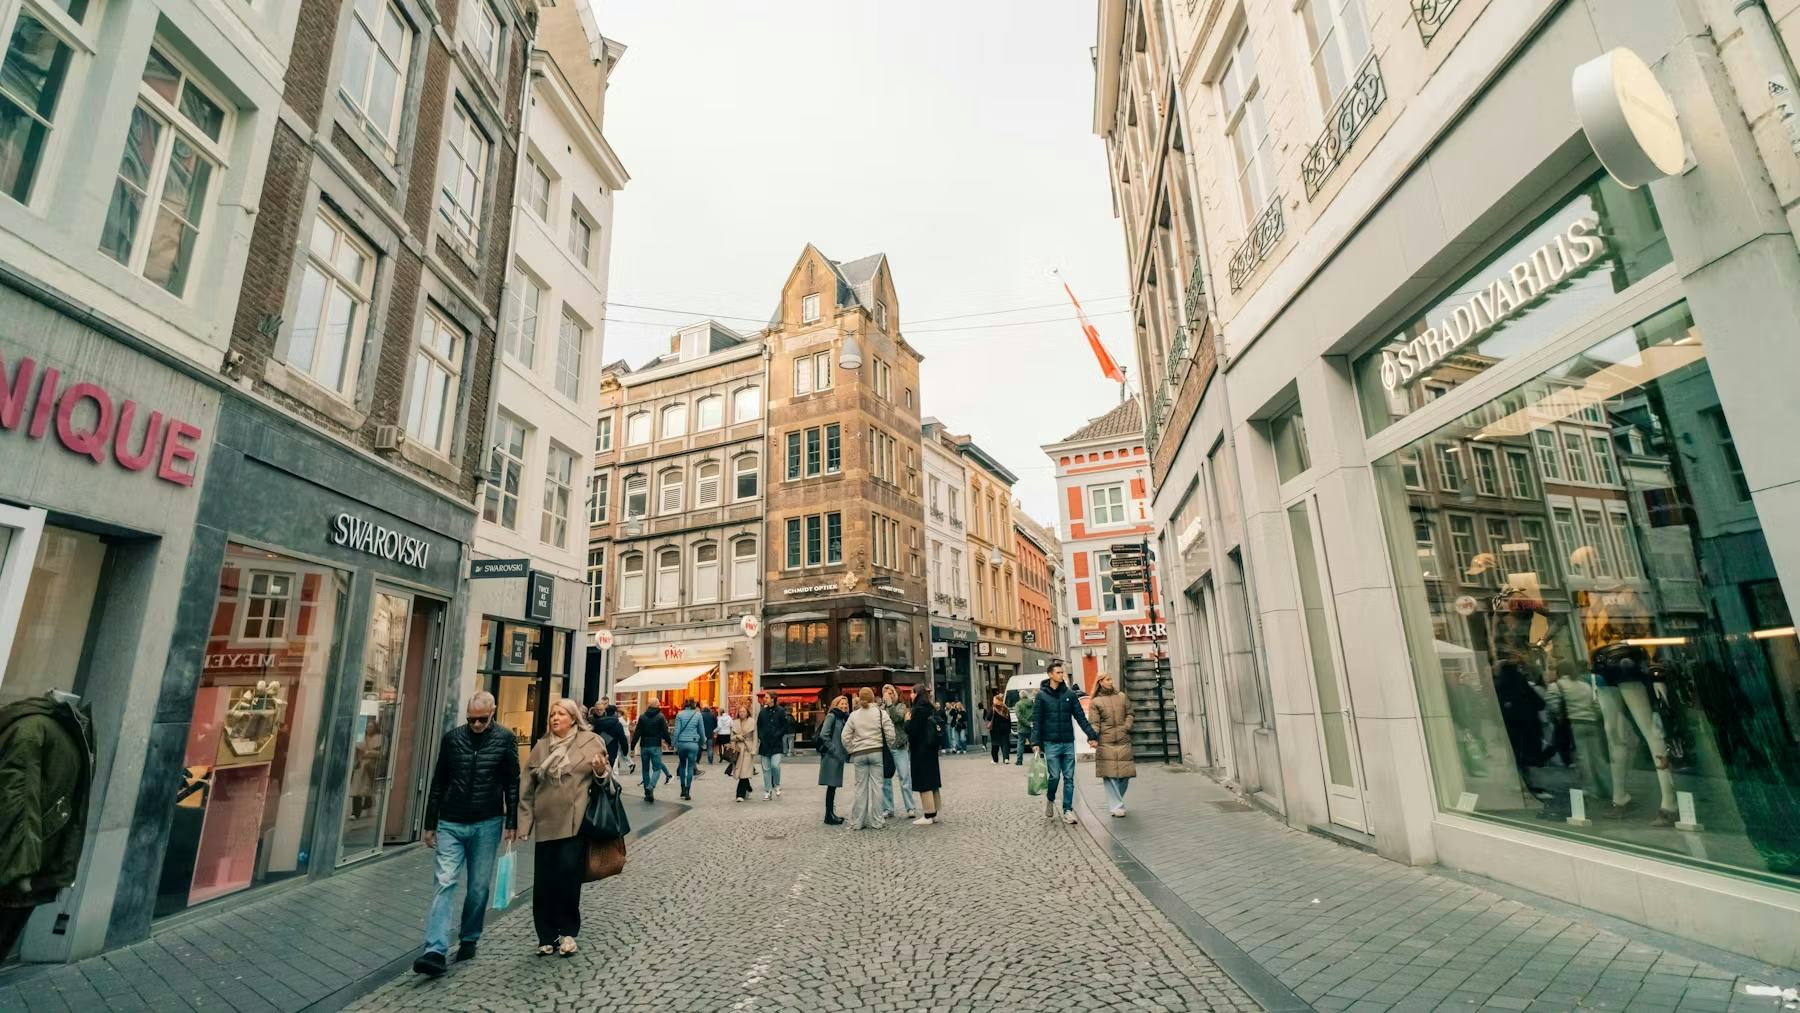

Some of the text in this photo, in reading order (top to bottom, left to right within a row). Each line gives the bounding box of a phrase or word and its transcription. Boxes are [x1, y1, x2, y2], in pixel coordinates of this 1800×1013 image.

[1398, 218, 1604, 383] STRADIVARIUS
[334, 513, 430, 569] SWAROVSKI
[484, 563, 523, 572] SWAROVSKI
[538, 585, 550, 594] TWICE
[784, 586, 813, 594] SCHMIDT
[541, 593, 546, 601] AS
[538, 600, 547, 608] NICE
